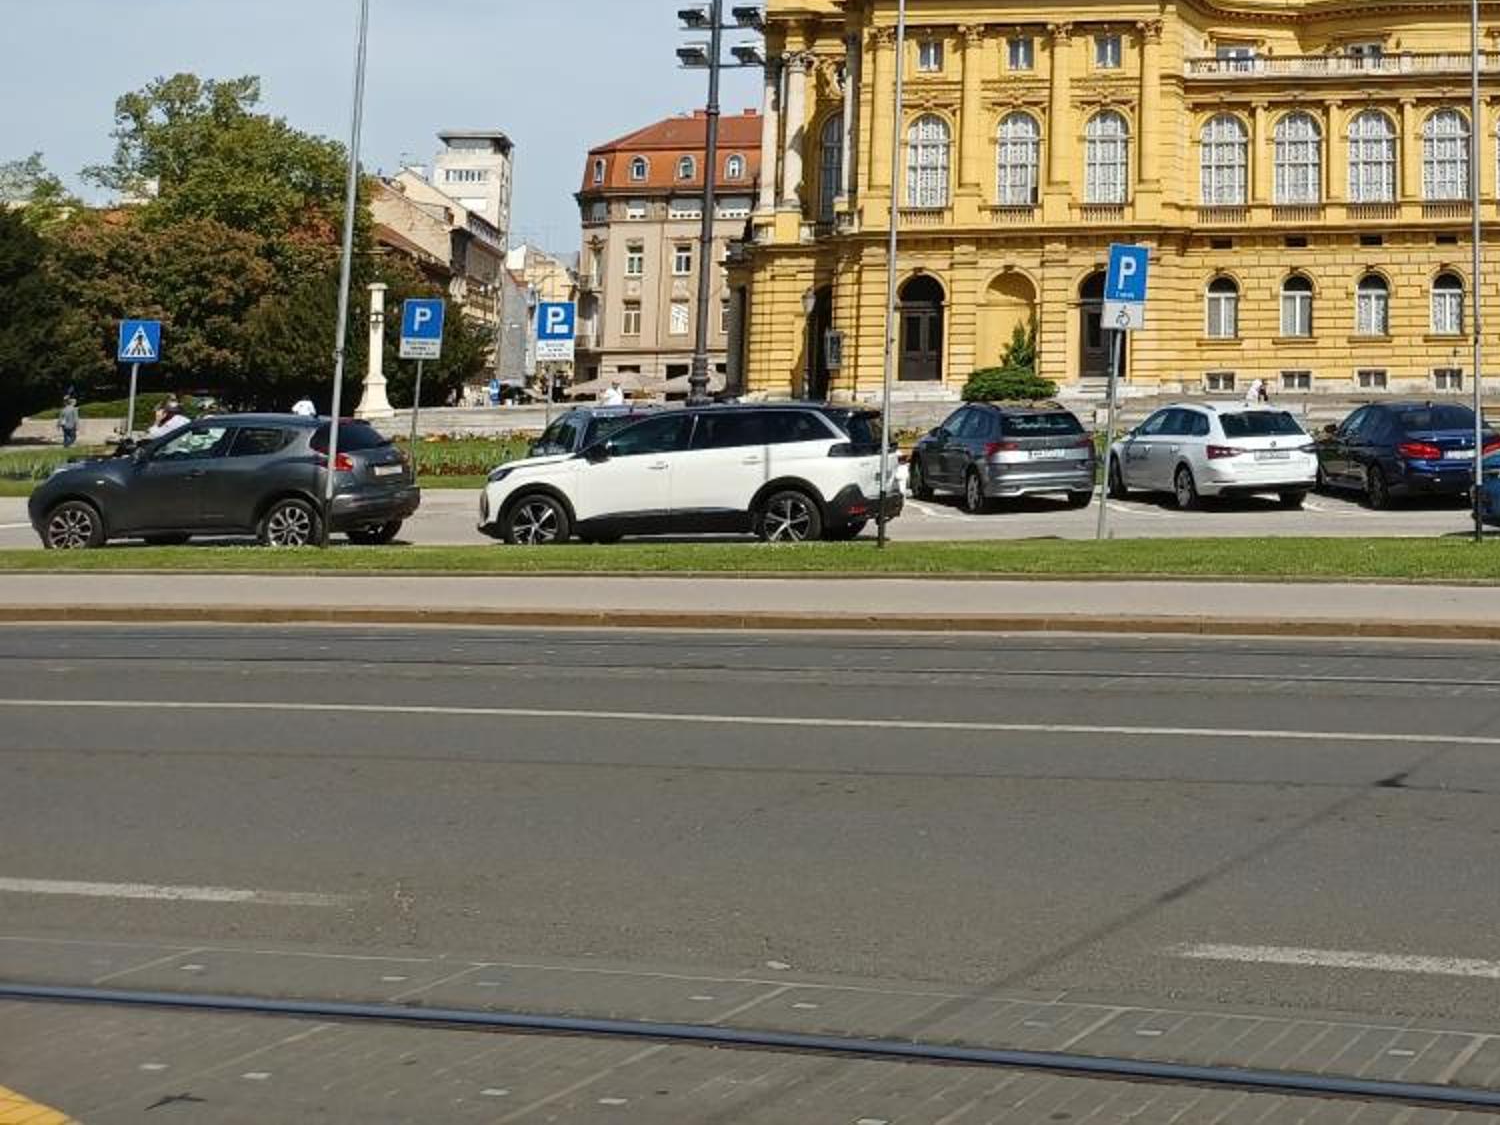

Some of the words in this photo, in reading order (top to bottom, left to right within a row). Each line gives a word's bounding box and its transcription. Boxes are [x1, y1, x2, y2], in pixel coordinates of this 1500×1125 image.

[1118, 256, 1136, 289] P
[413, 307, 432, 331] P
[546, 307, 565, 333] P
